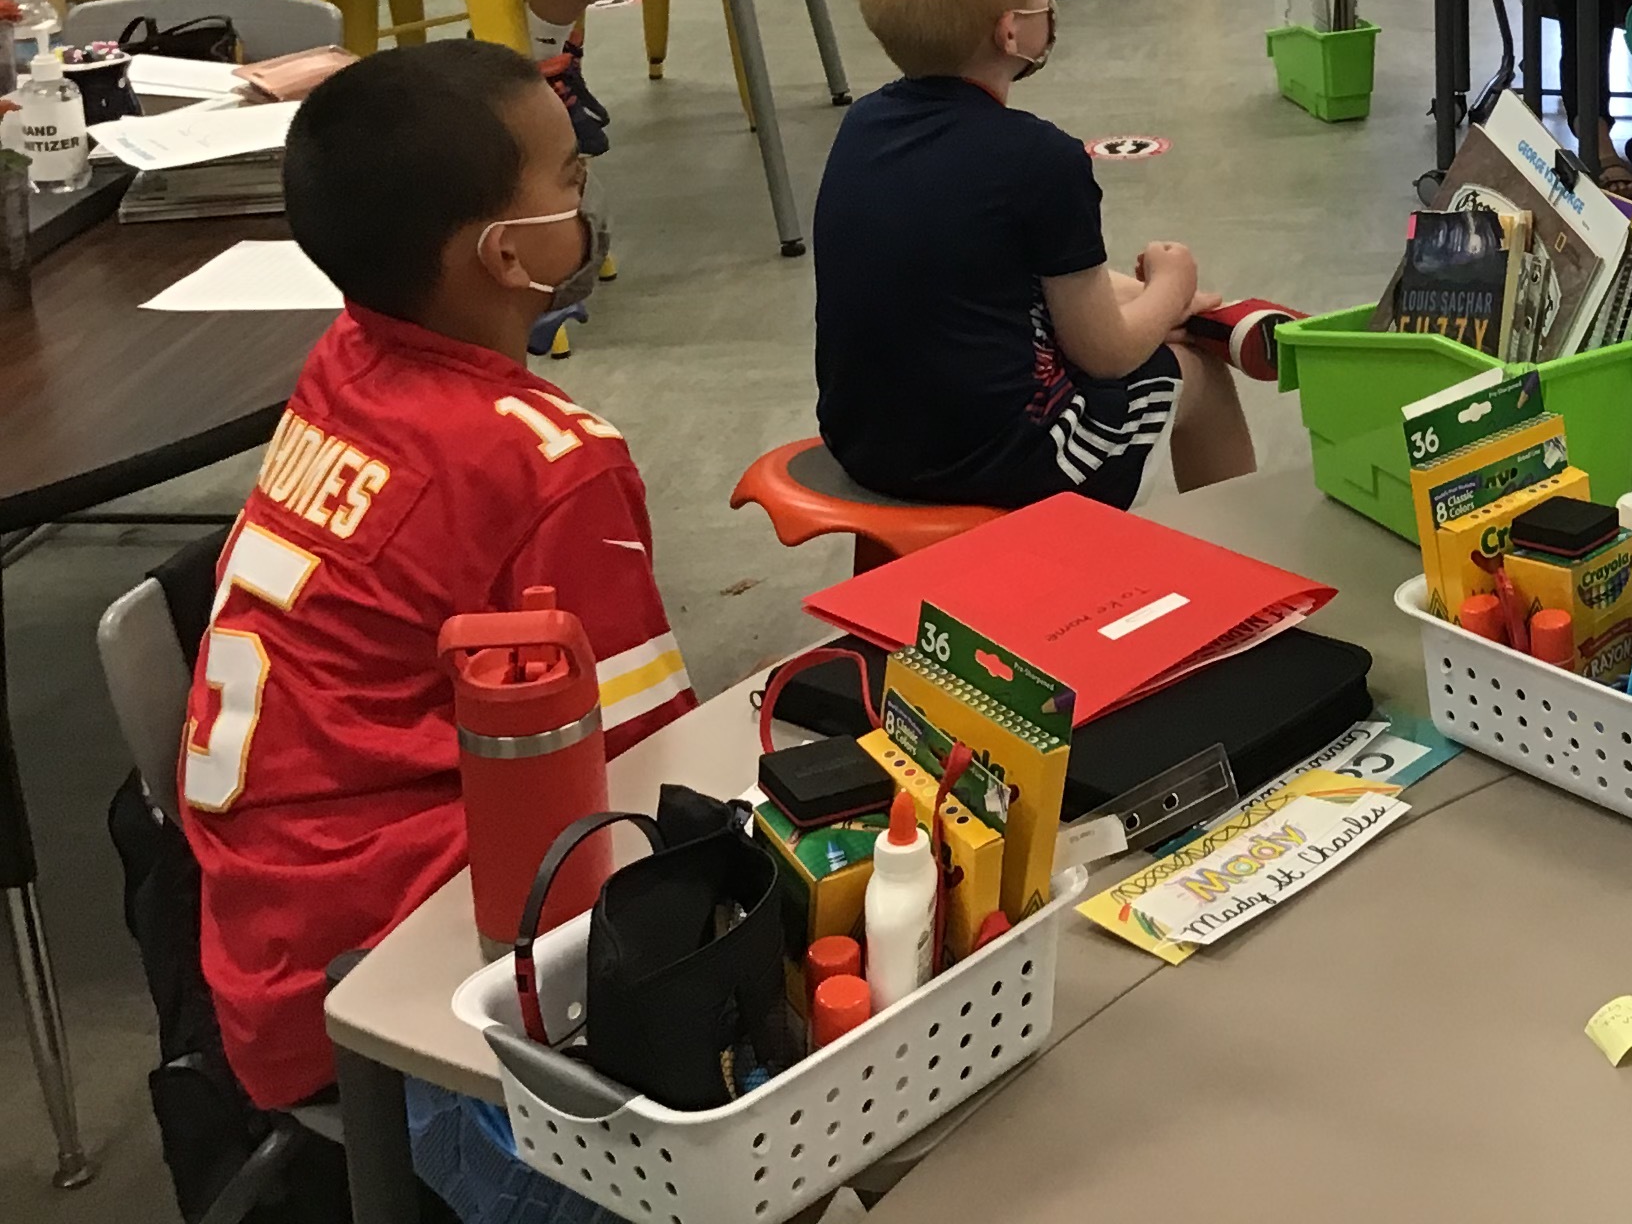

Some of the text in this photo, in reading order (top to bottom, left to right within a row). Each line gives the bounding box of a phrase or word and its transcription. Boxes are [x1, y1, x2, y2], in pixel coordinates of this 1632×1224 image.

[1517, 139, 1548, 175] GEORGE
[1402, 289, 1493, 314] LOUIS SACHAR
[494, 388, 624, 463] 15
[1410, 426, 1440, 460] 36
[1436, 501, 1448, 524] 8
[1447, 489, 1475, 508] Classic
[1449, 501, 1475, 519] Colors
[1581, 551, 1632, 589] Crayola
[921, 621, 951, 662] 36
[174, 508, 322, 814] 5
[885, 710, 896, 735] 8
[895, 729, 917, 756] Colors
[1181, 891, 1278, 937] Mady
[1298, 805, 1386, 866] Charles
[1182, 821, 1310, 904] Mady
